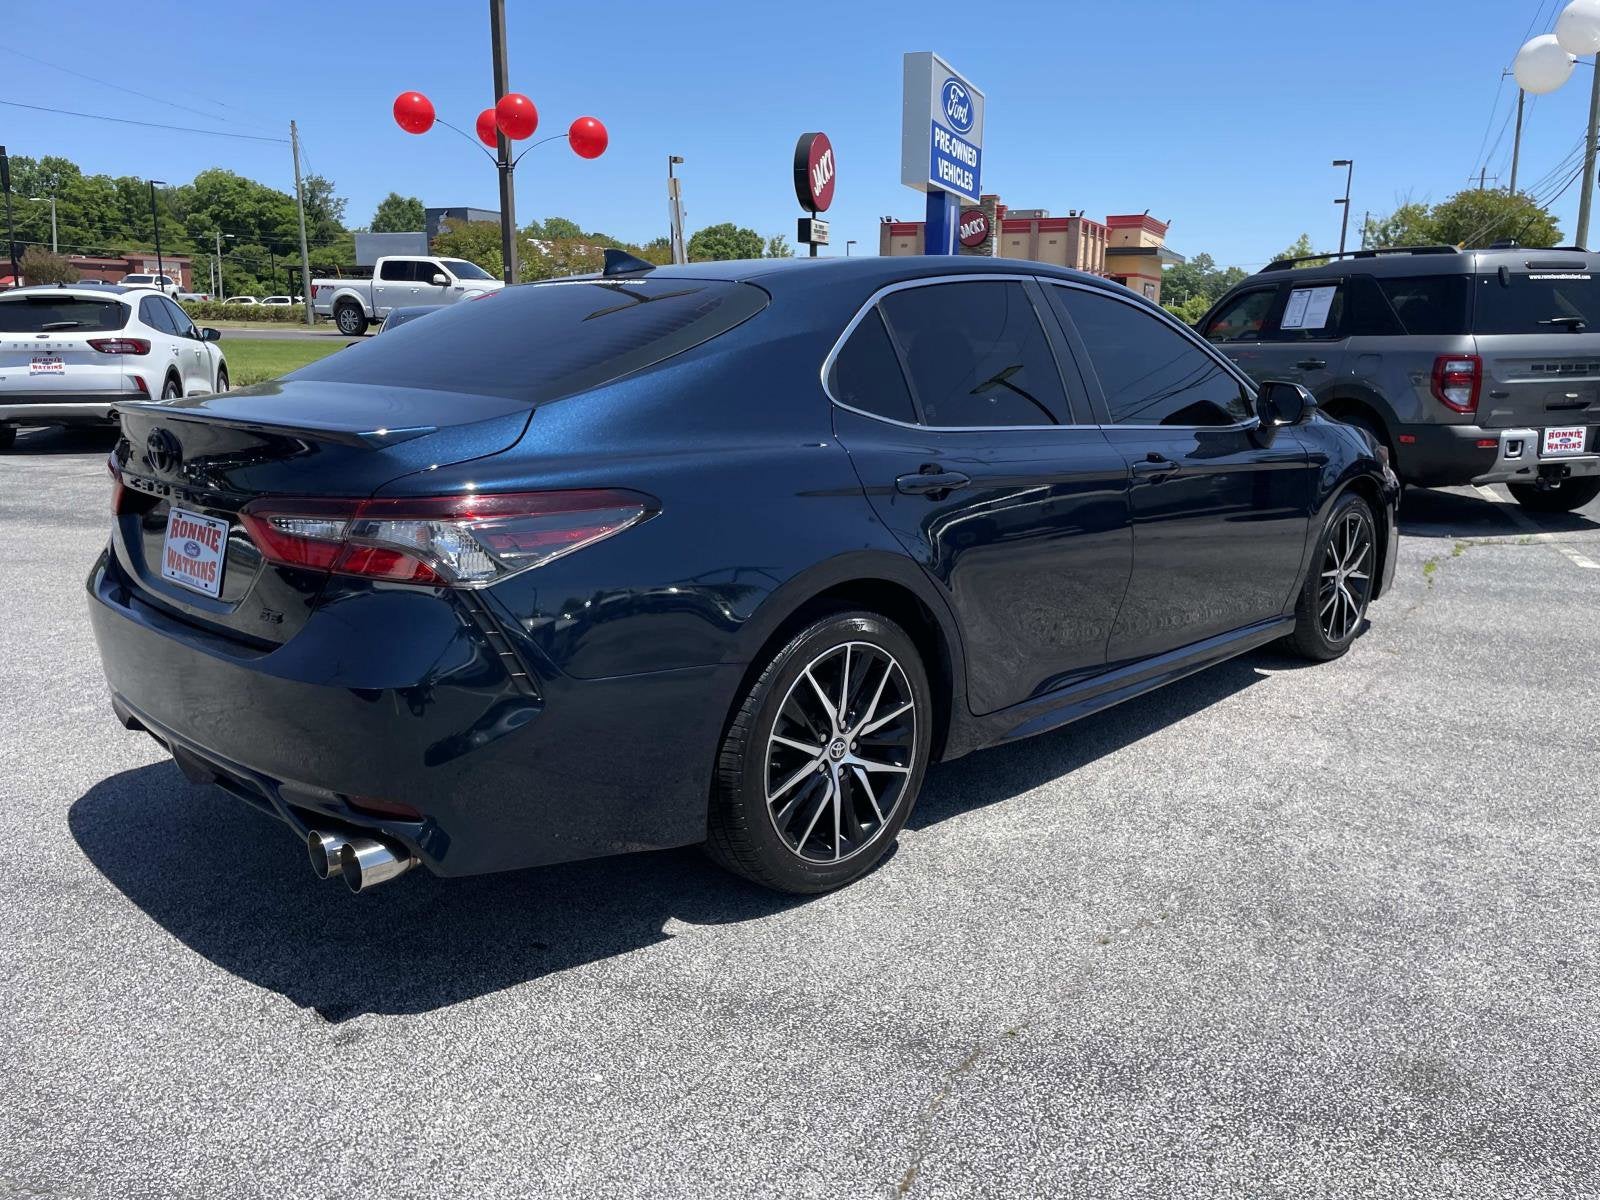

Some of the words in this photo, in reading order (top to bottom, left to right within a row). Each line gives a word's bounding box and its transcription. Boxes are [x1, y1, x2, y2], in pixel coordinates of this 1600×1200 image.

[947, 85, 969, 125] Ford
[934, 126, 977, 168] PRE-OWNED
[938, 156, 974, 192] VEHICLES
[1547, 441, 1582, 450] WATKINS
[1548, 430, 1583, 440] RONNIE
[170, 518, 222, 554] RONNIE
[167, 546, 217, 583] WATKINS
